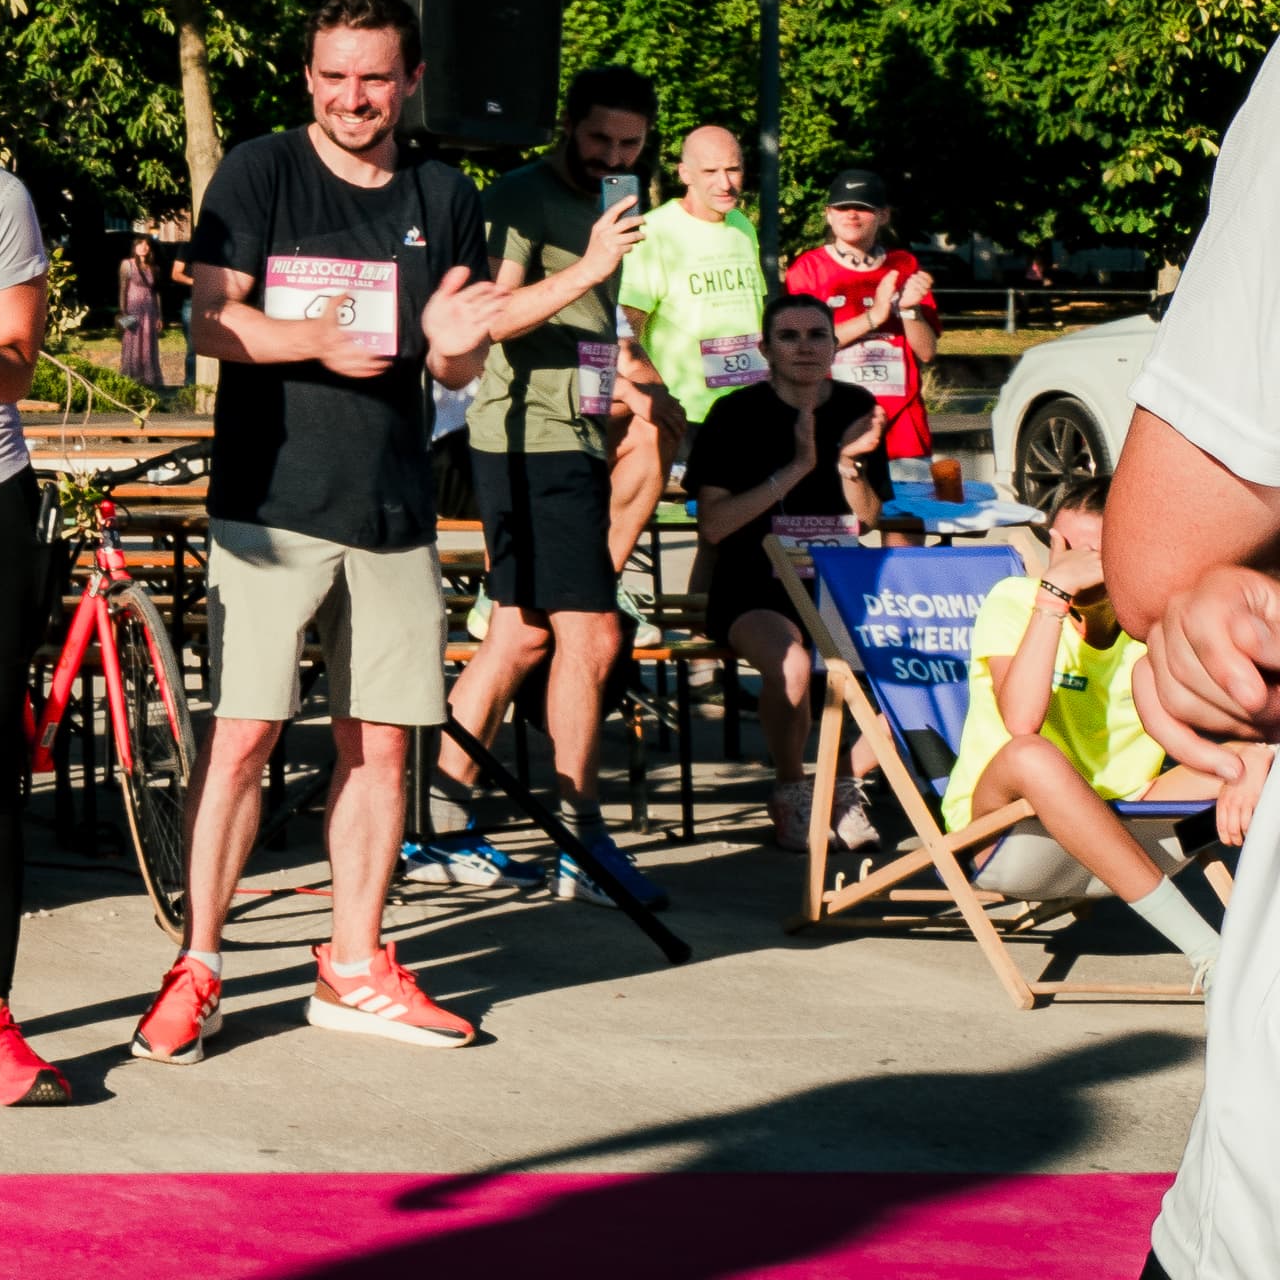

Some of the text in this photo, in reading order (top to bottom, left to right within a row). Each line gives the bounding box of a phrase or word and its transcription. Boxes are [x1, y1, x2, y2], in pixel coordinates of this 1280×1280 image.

[269, 260, 308, 274] MILES
[310, 261, 357, 278] SOCIAL
[723, 353, 751, 372] 30
[852, 364, 888, 382] 133
[855, 624, 973, 652] TES WEEK
[892, 657, 958, 683] SONT
